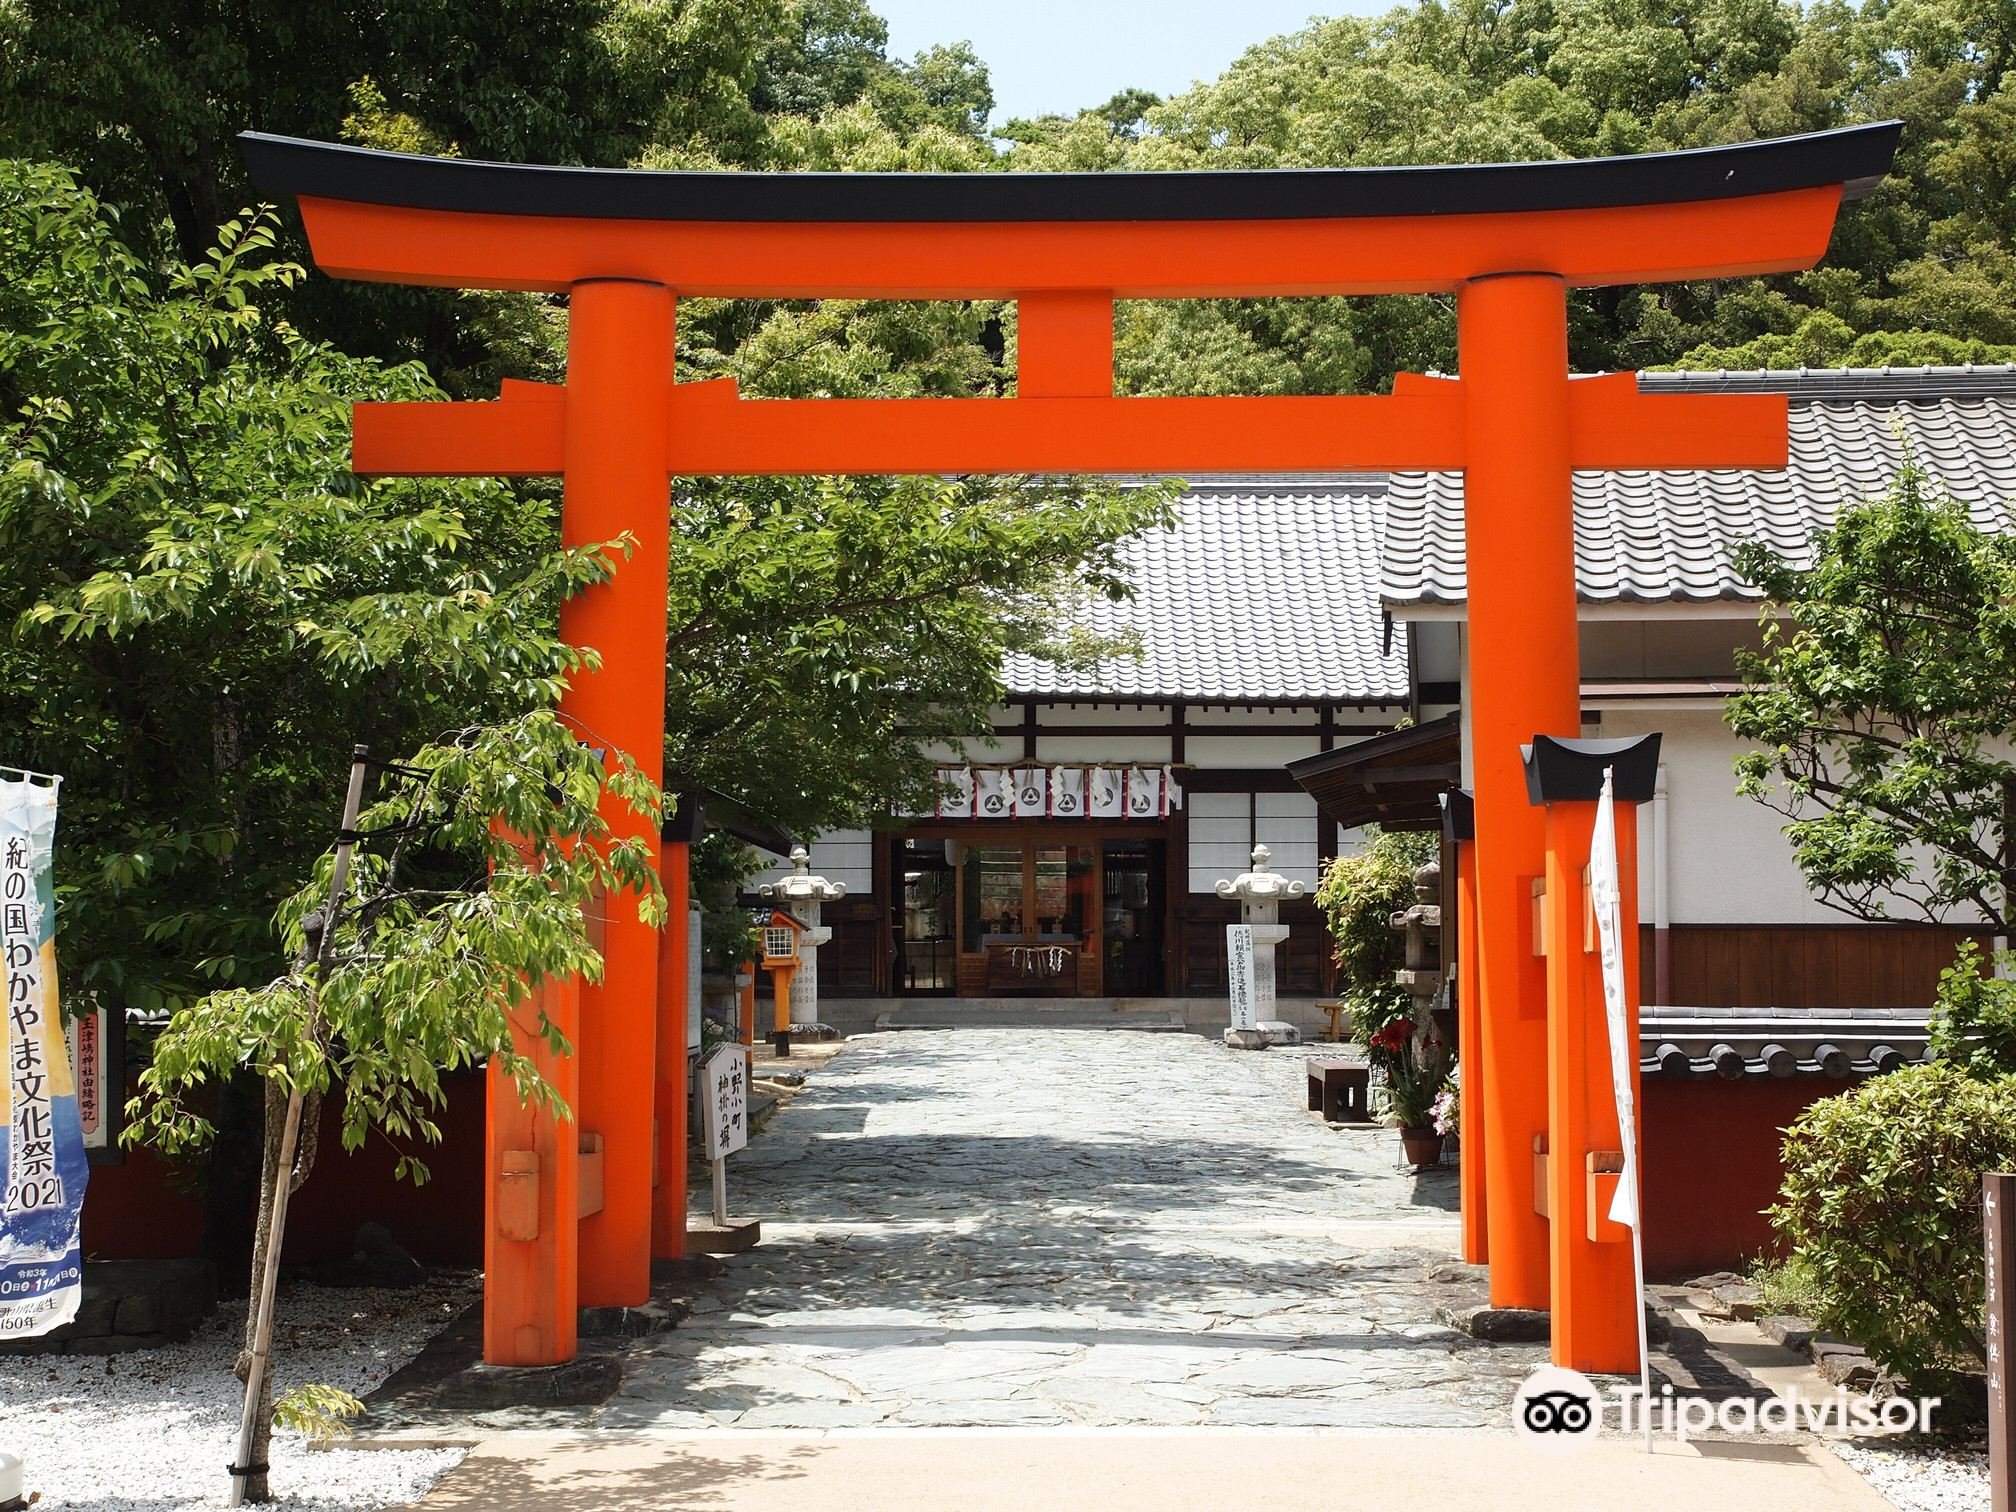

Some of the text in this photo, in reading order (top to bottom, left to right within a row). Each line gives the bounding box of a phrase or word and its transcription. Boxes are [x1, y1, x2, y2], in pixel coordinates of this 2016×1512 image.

[6, 836, 53, 1177] 紀の国わかやま文化祭
[731, 1058, 742, 1130] 小野小町
[7, 1178, 61, 1212] 2021
[18, 1269, 48, 1279] 令和3年
